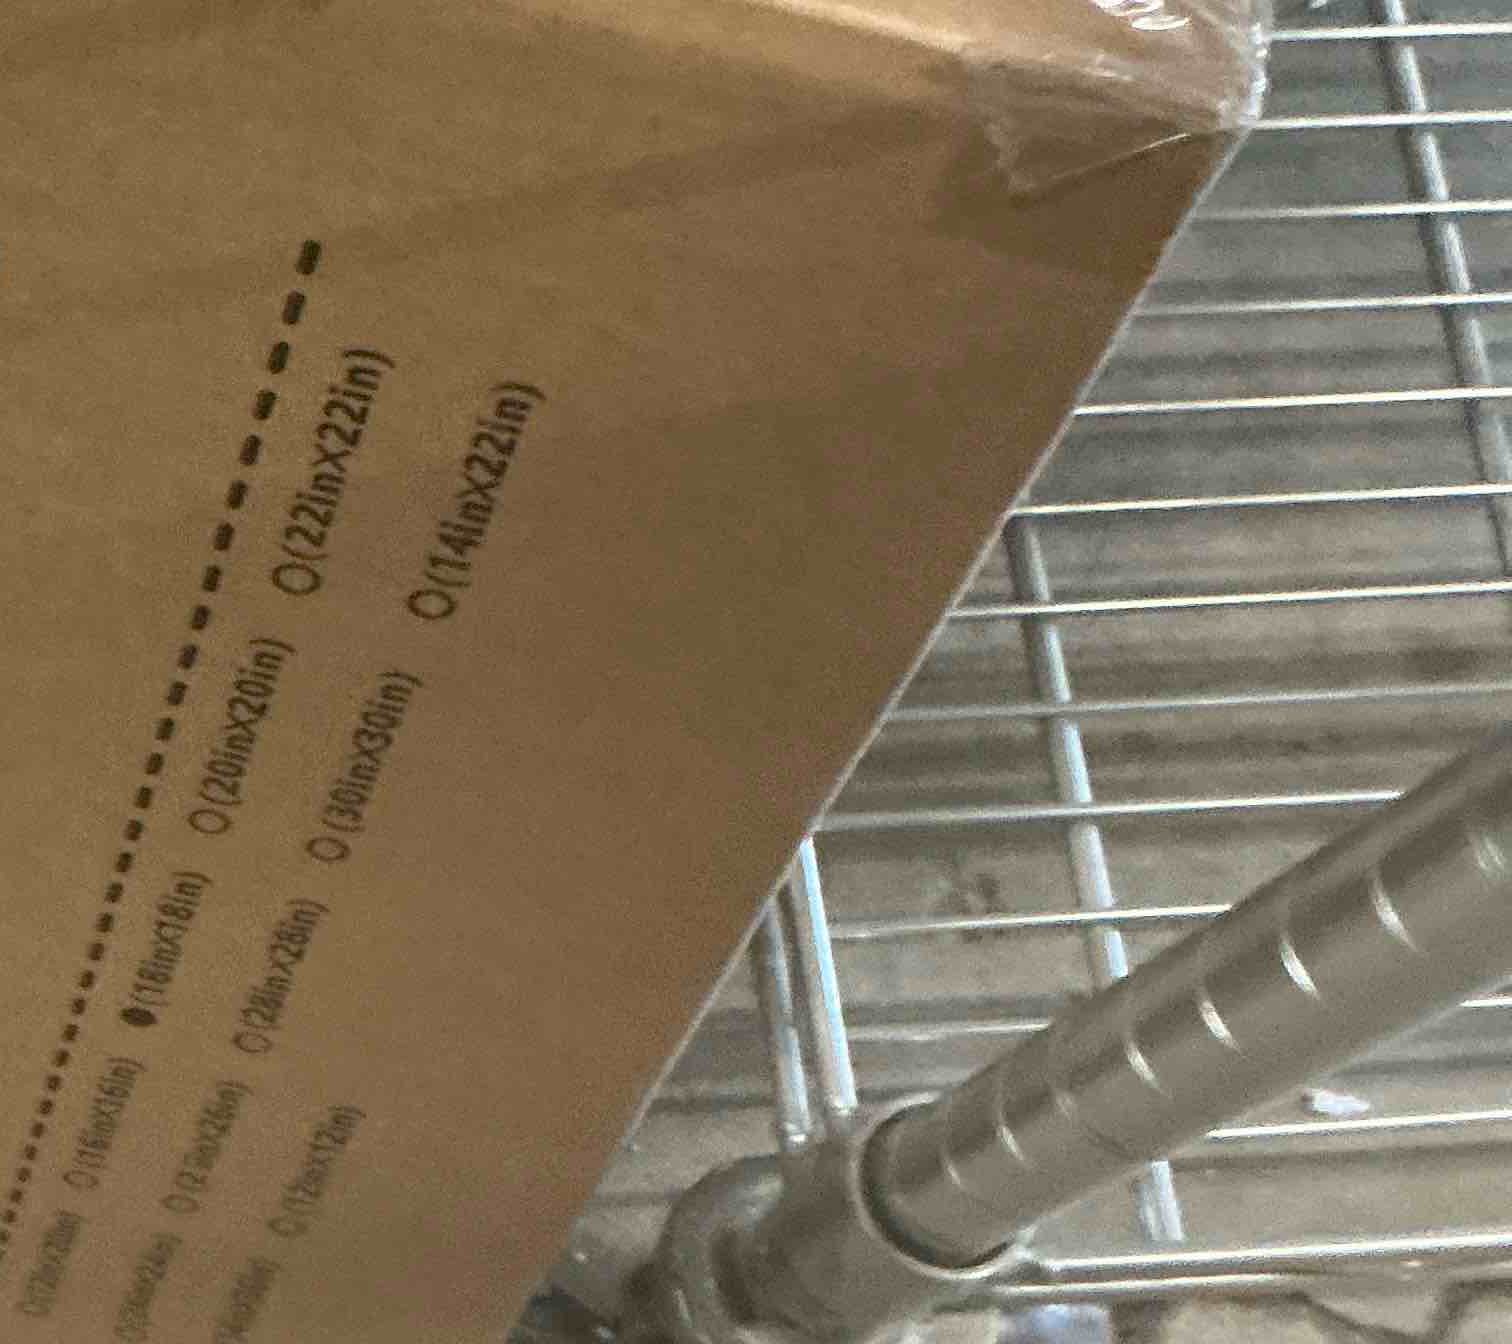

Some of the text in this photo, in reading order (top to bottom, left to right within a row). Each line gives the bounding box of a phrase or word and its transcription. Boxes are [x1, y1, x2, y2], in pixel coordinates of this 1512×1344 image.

[132, 870, 214, 1009] (18inX18in)
[199, 637, 296, 807] (20inX20in)
[281, 349, 396, 560] (22inX22in)
[239, 896, 331, 1031] (28inX28in)
[321, 667, 424, 834] (30inX30in)
[424, 380, 547, 588] (14inX22in)
